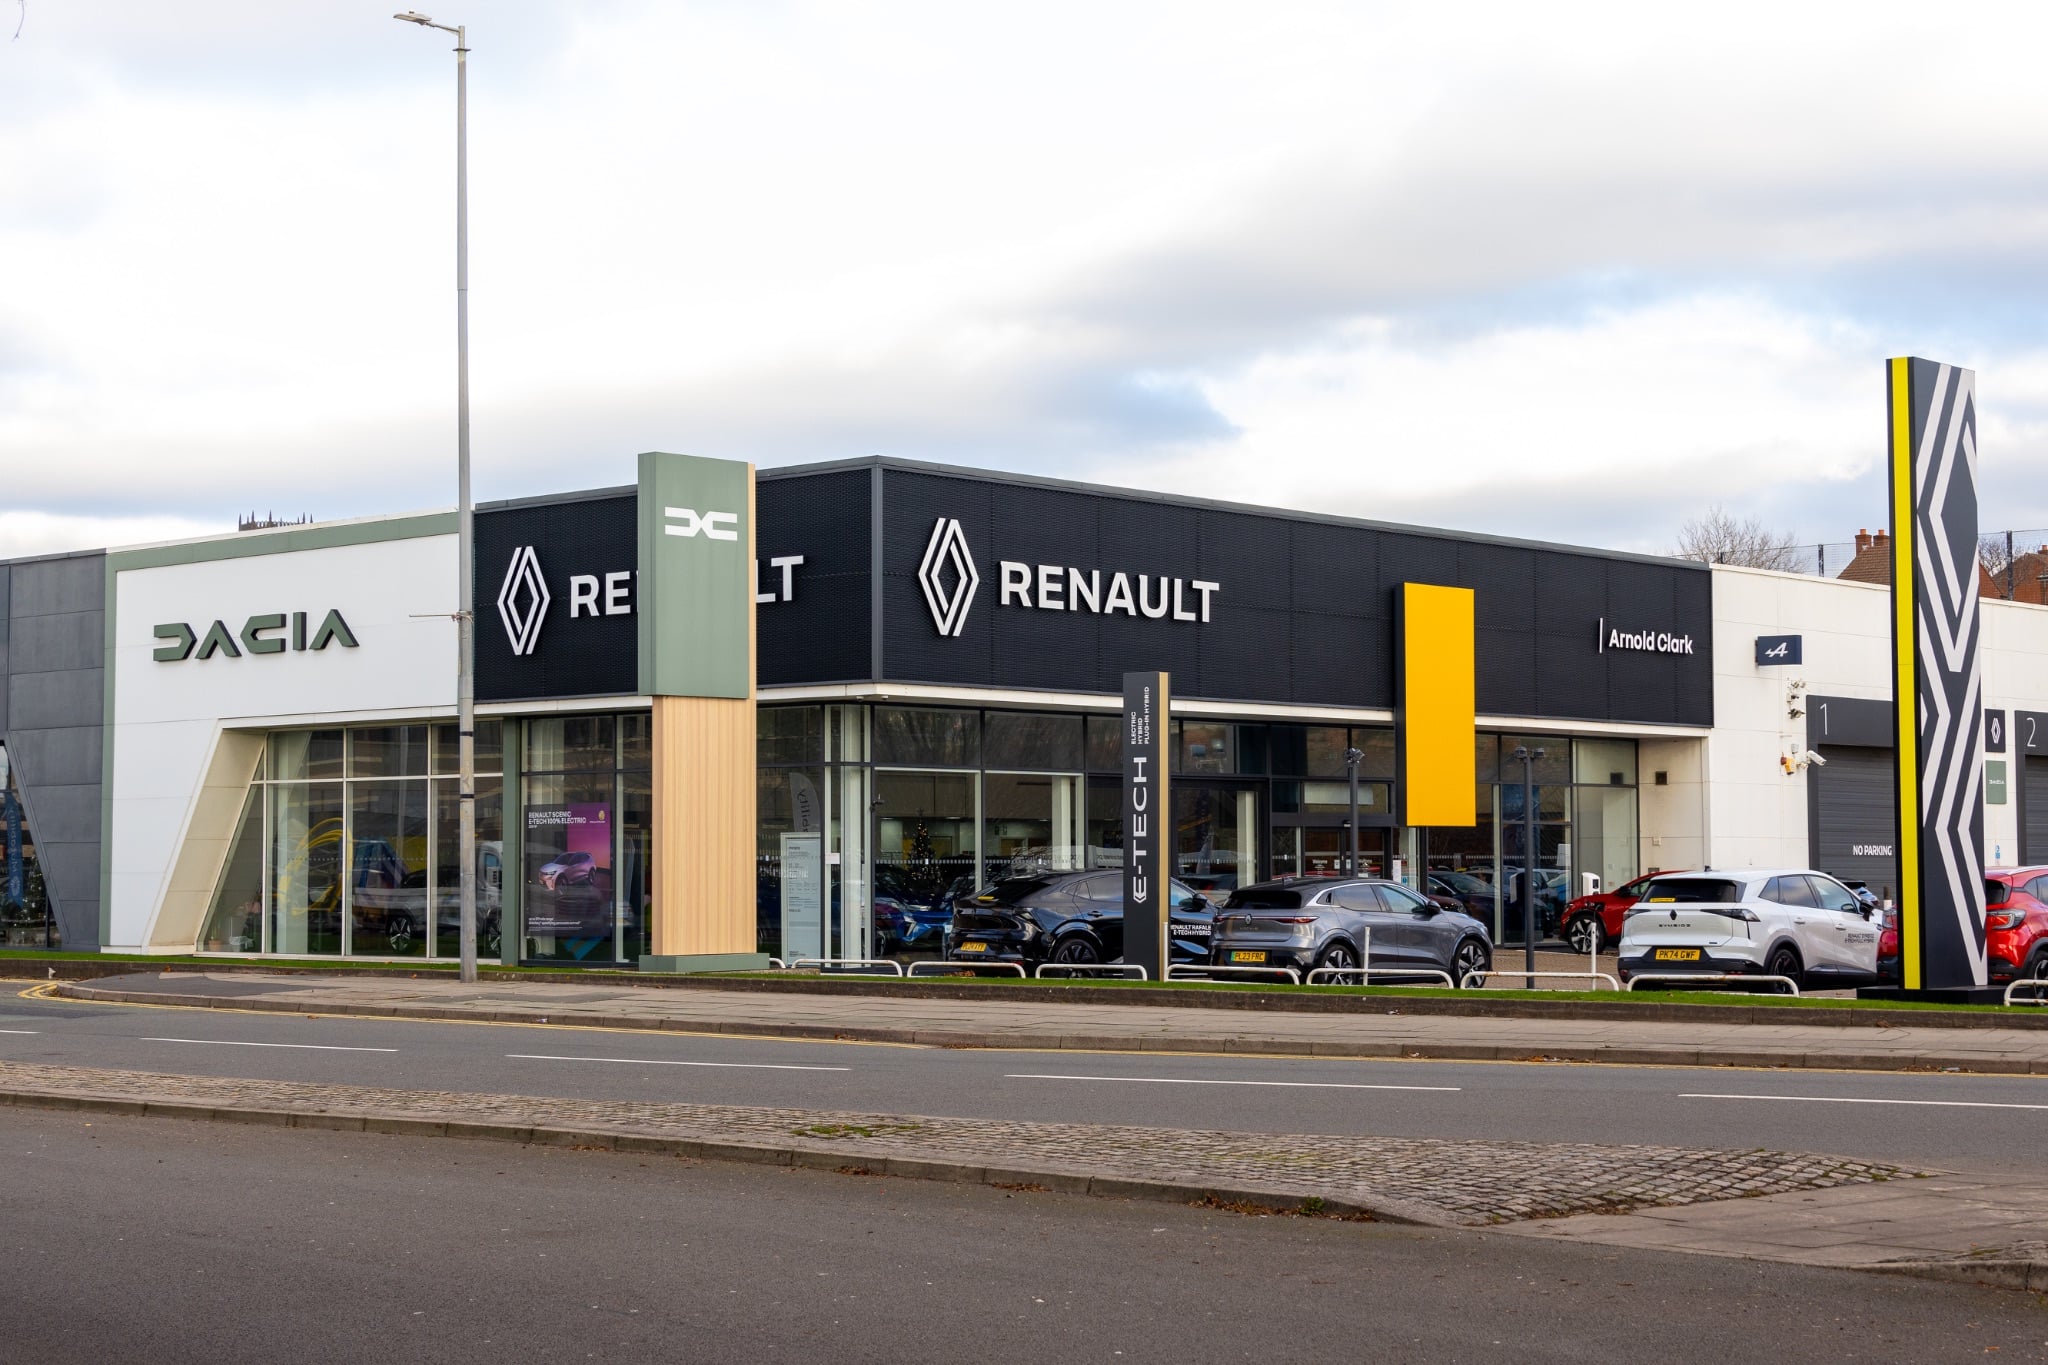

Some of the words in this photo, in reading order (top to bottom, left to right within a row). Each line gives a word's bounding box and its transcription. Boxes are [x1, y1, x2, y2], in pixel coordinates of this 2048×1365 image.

[570, 555, 804, 618] RELT
[1000, 560, 1220, 623] RENAULT
[153, 608, 360, 662] DACIA
[1608, 629, 1655, 651] Arnold
[1657, 633, 1694, 655] Clark
[1819, 703, 1828, 735] 1
[2026, 717, 2036, 748] 2
[1133, 757, 1147, 904] E-TECH
[1852, 845, 1863, 856] NO
[1864, 845, 1892, 856] PARKING
[1234, 952, 1250, 961] PL23
[1250, 952, 1264, 961] FRC
[1658, 950, 1679, 959] PK74
[1680, 950, 1697, 959] GWF
